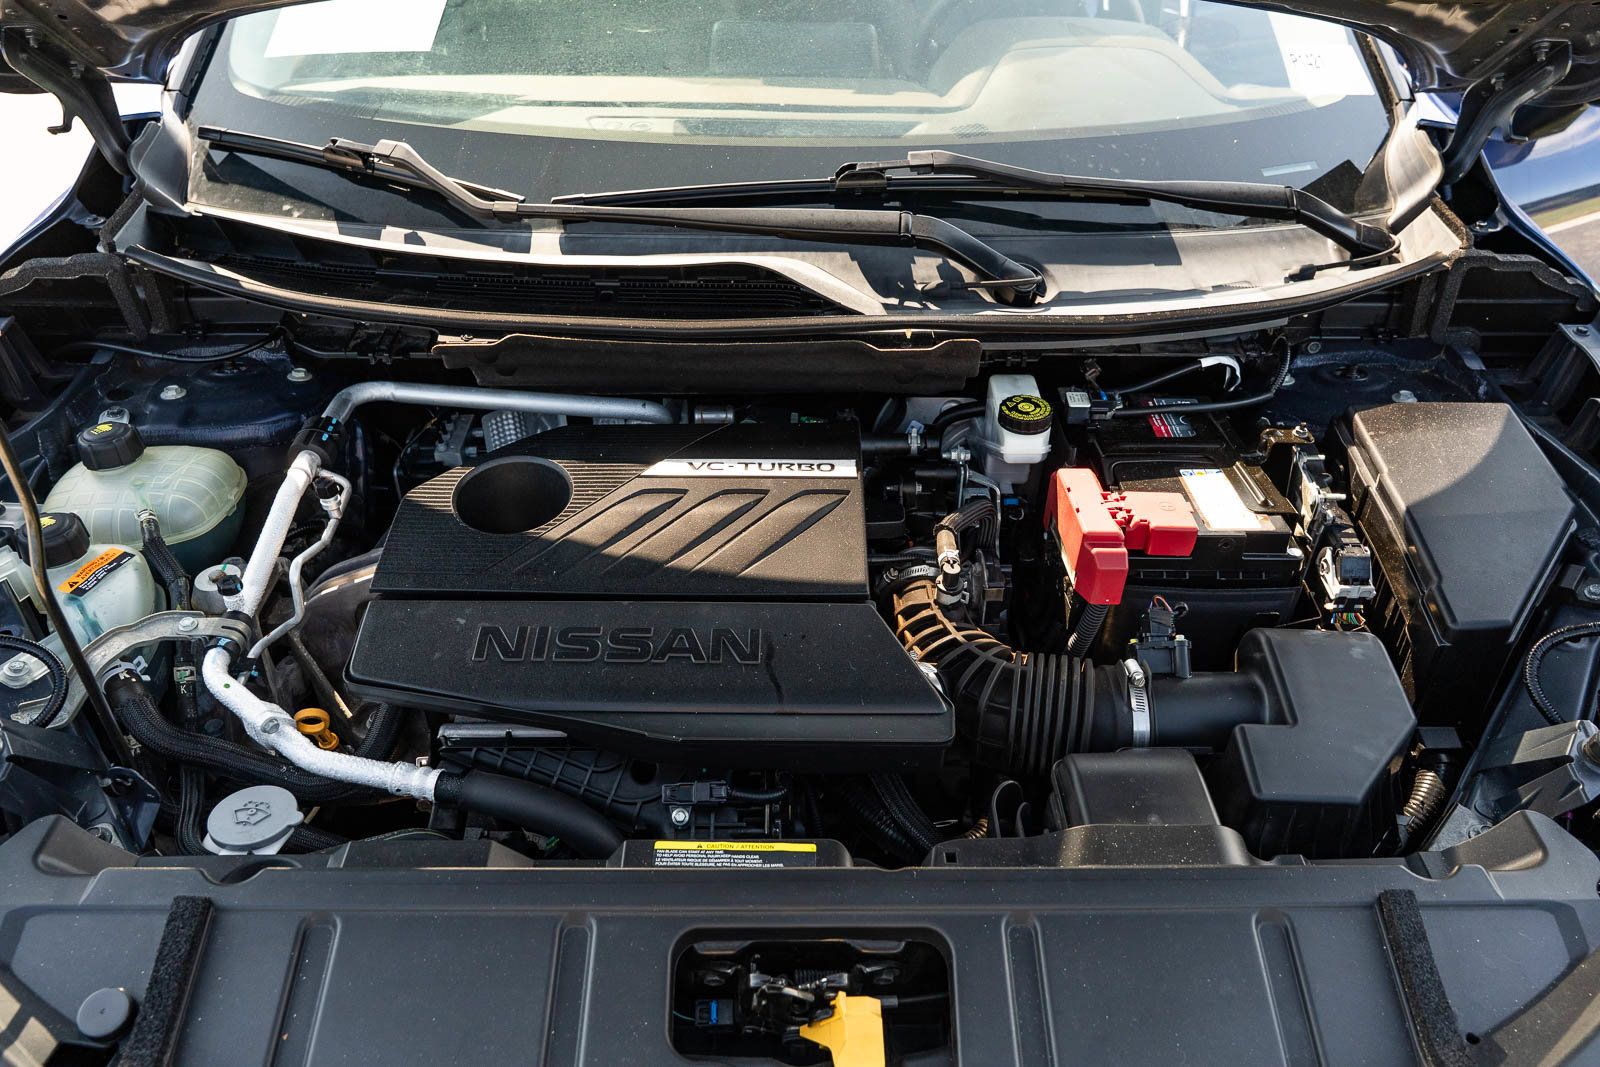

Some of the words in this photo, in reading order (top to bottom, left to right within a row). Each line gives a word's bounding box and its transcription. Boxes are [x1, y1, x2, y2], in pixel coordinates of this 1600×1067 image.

[687, 461, 836, 472] VC-TURBO
[472, 626, 762, 664] NISSAN
[180, 684, 186, 694] K
